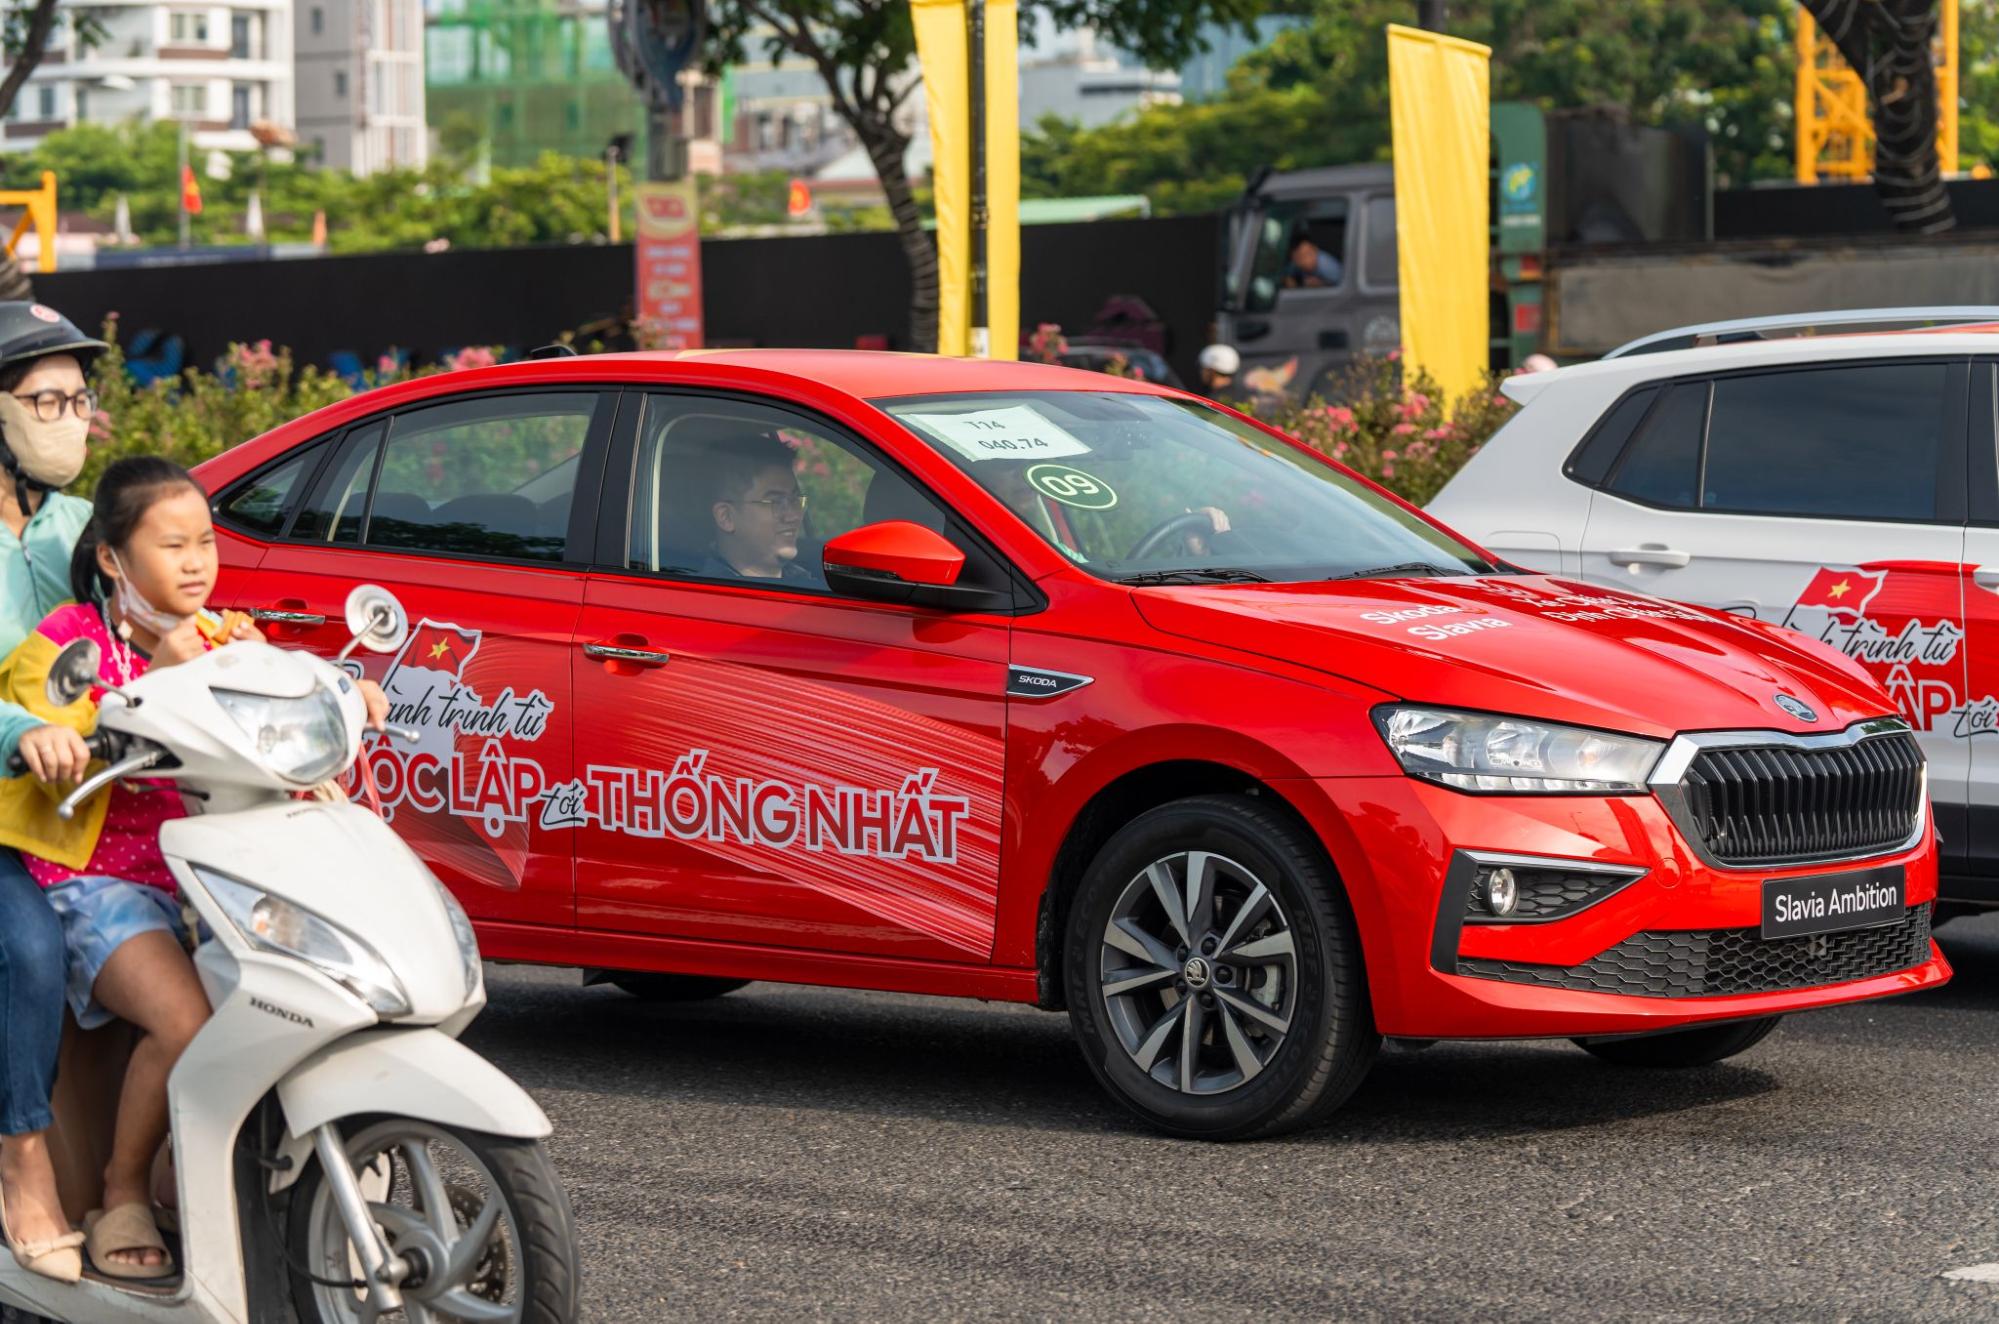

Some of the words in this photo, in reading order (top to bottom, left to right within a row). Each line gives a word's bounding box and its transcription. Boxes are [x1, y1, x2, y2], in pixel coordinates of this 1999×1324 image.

[978, 438, 1049, 450] 040.74
[1041, 474, 1100, 496] 09
[1360, 604, 1461, 625] Skoda
[1407, 617, 1513, 640] Slavia
[1018, 675, 1057, 688] SKODA
[437, 687, 511, 734] trình
[514, 693, 551, 737] từ
[451, 739, 545, 836] LẬP
[588, 750, 798, 847] THỐNG
[806, 769, 968, 862] NHẤT
[1774, 891, 1825, 923] Slavia
[1828, 882, 1897, 916] Ambition
[249, 996, 315, 1028] HONDA
